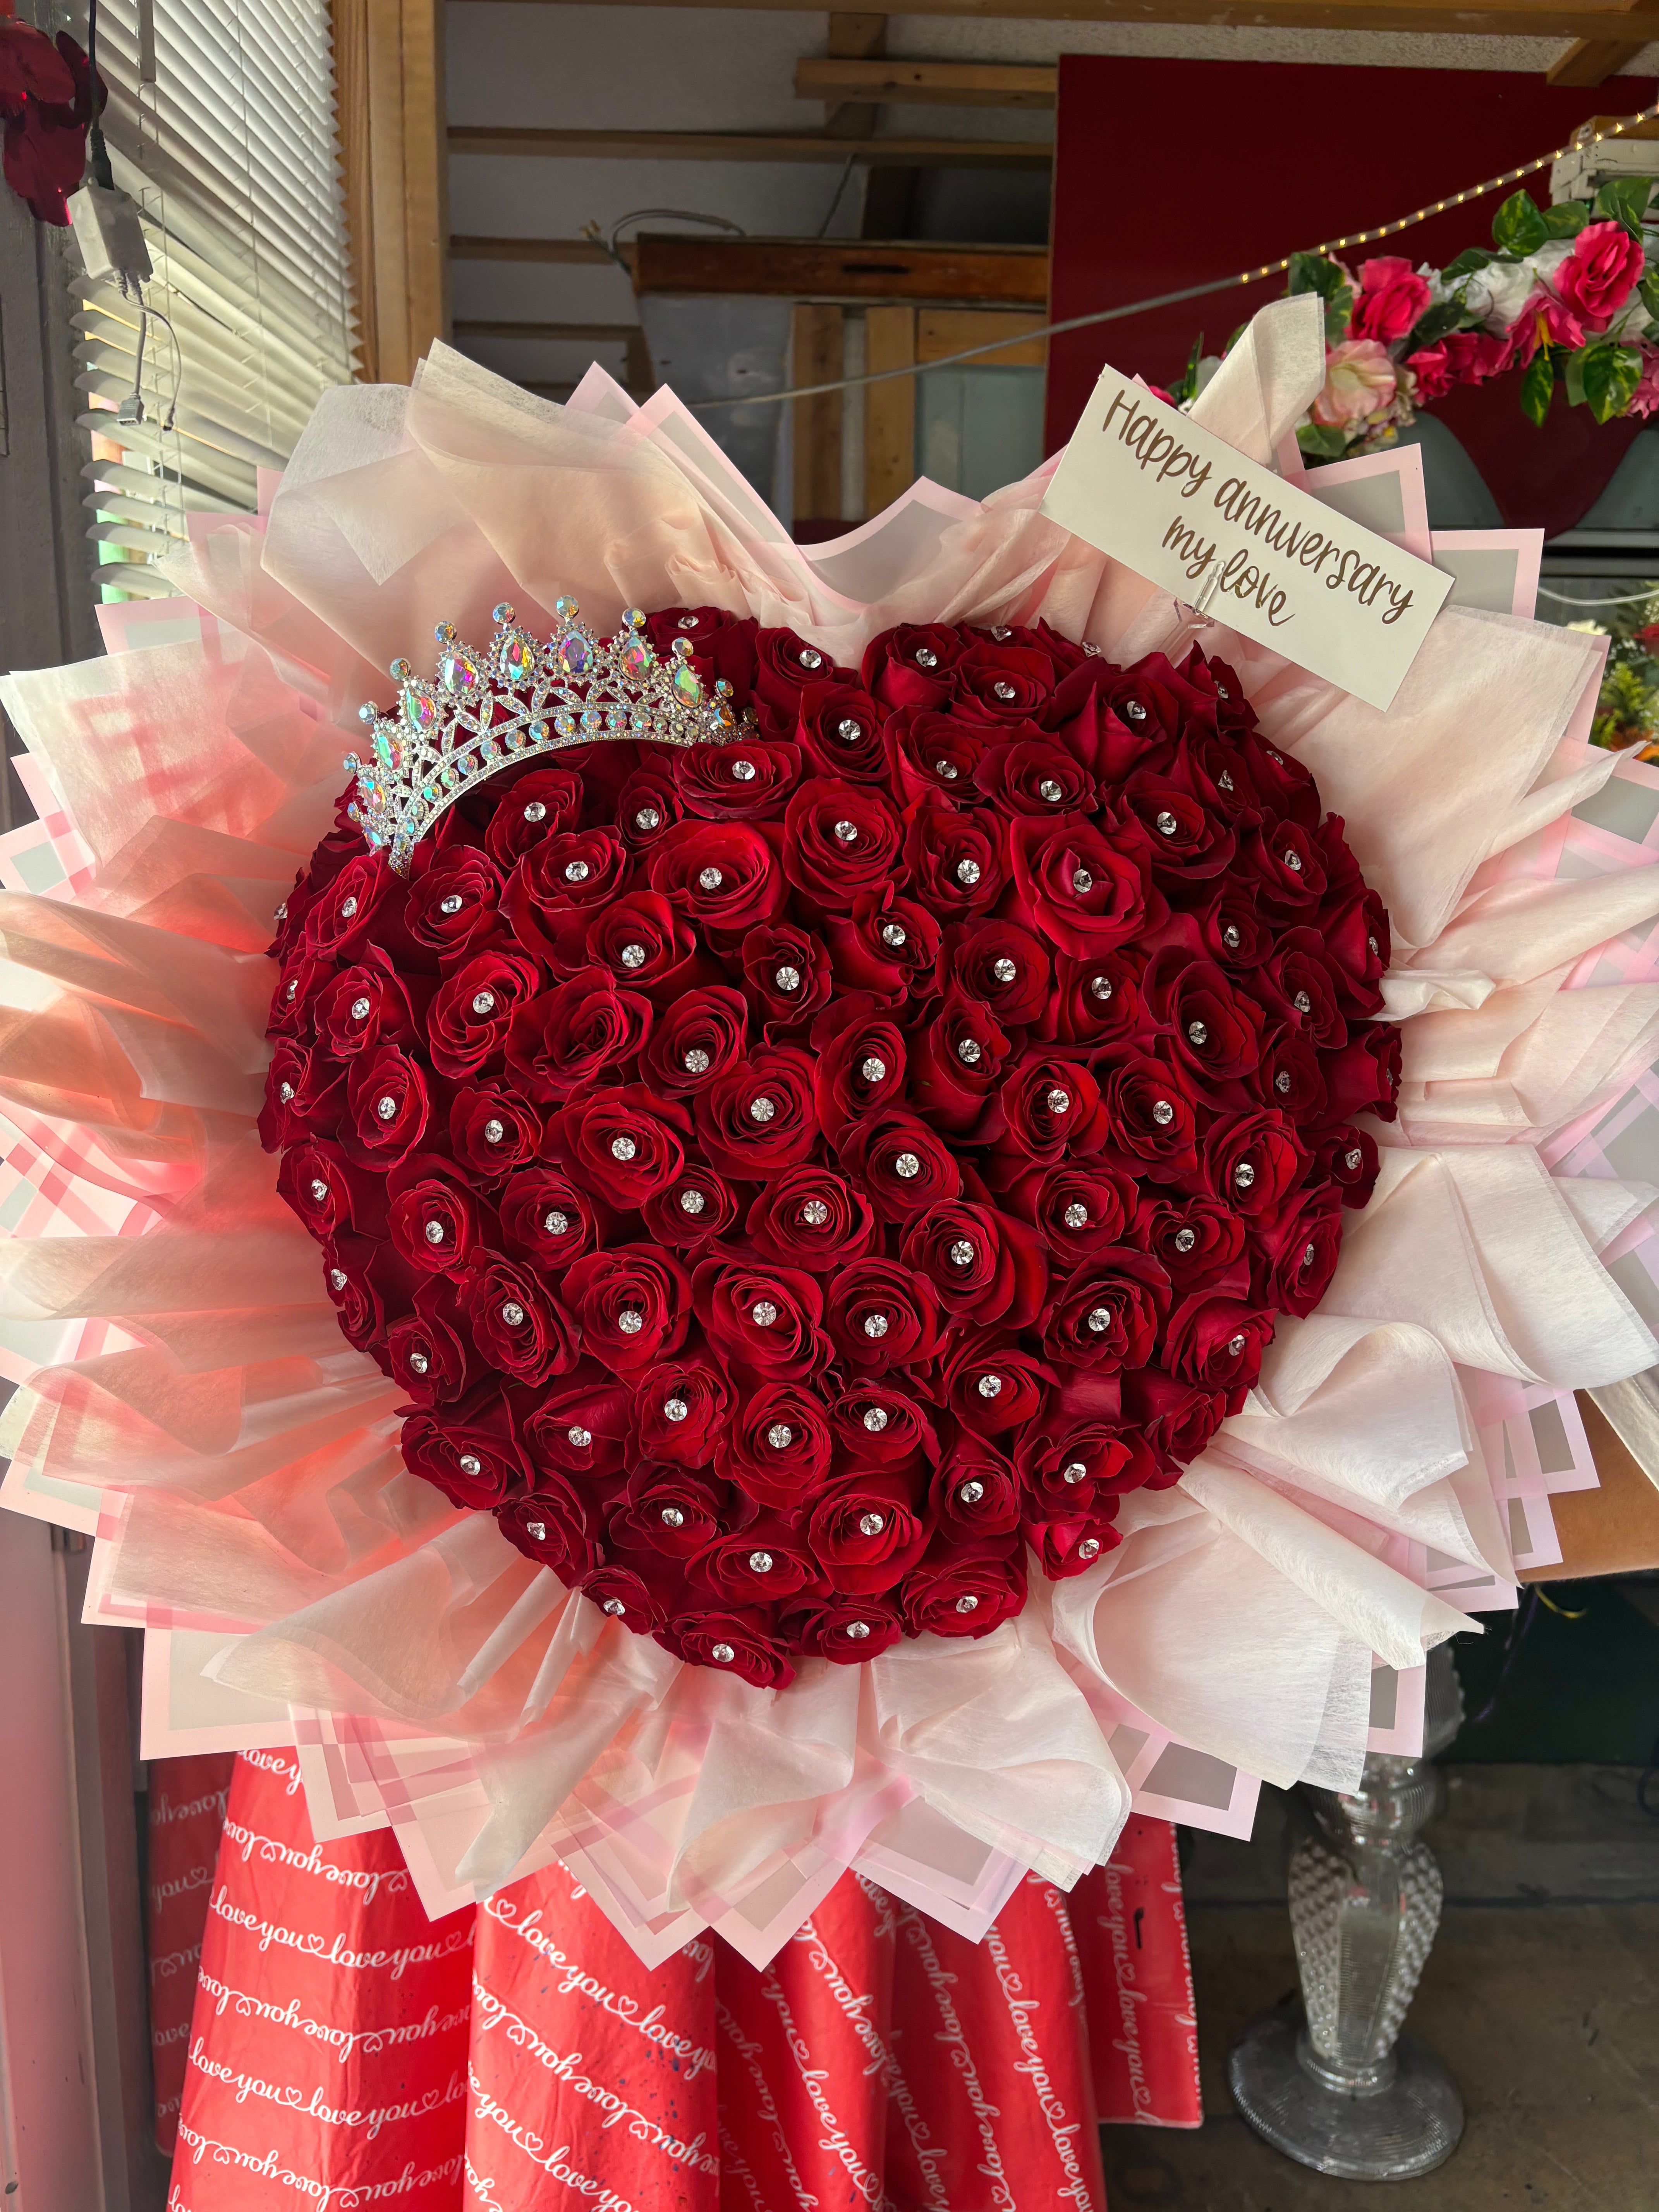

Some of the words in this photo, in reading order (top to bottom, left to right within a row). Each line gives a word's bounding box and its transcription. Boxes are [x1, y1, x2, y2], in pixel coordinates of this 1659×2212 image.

[1103, 390, 1212, 497] Happy
[1214, 478, 1413, 624] anniversary
[1162, 515, 1216, 579] my
[1220, 549, 1295, 626] love
